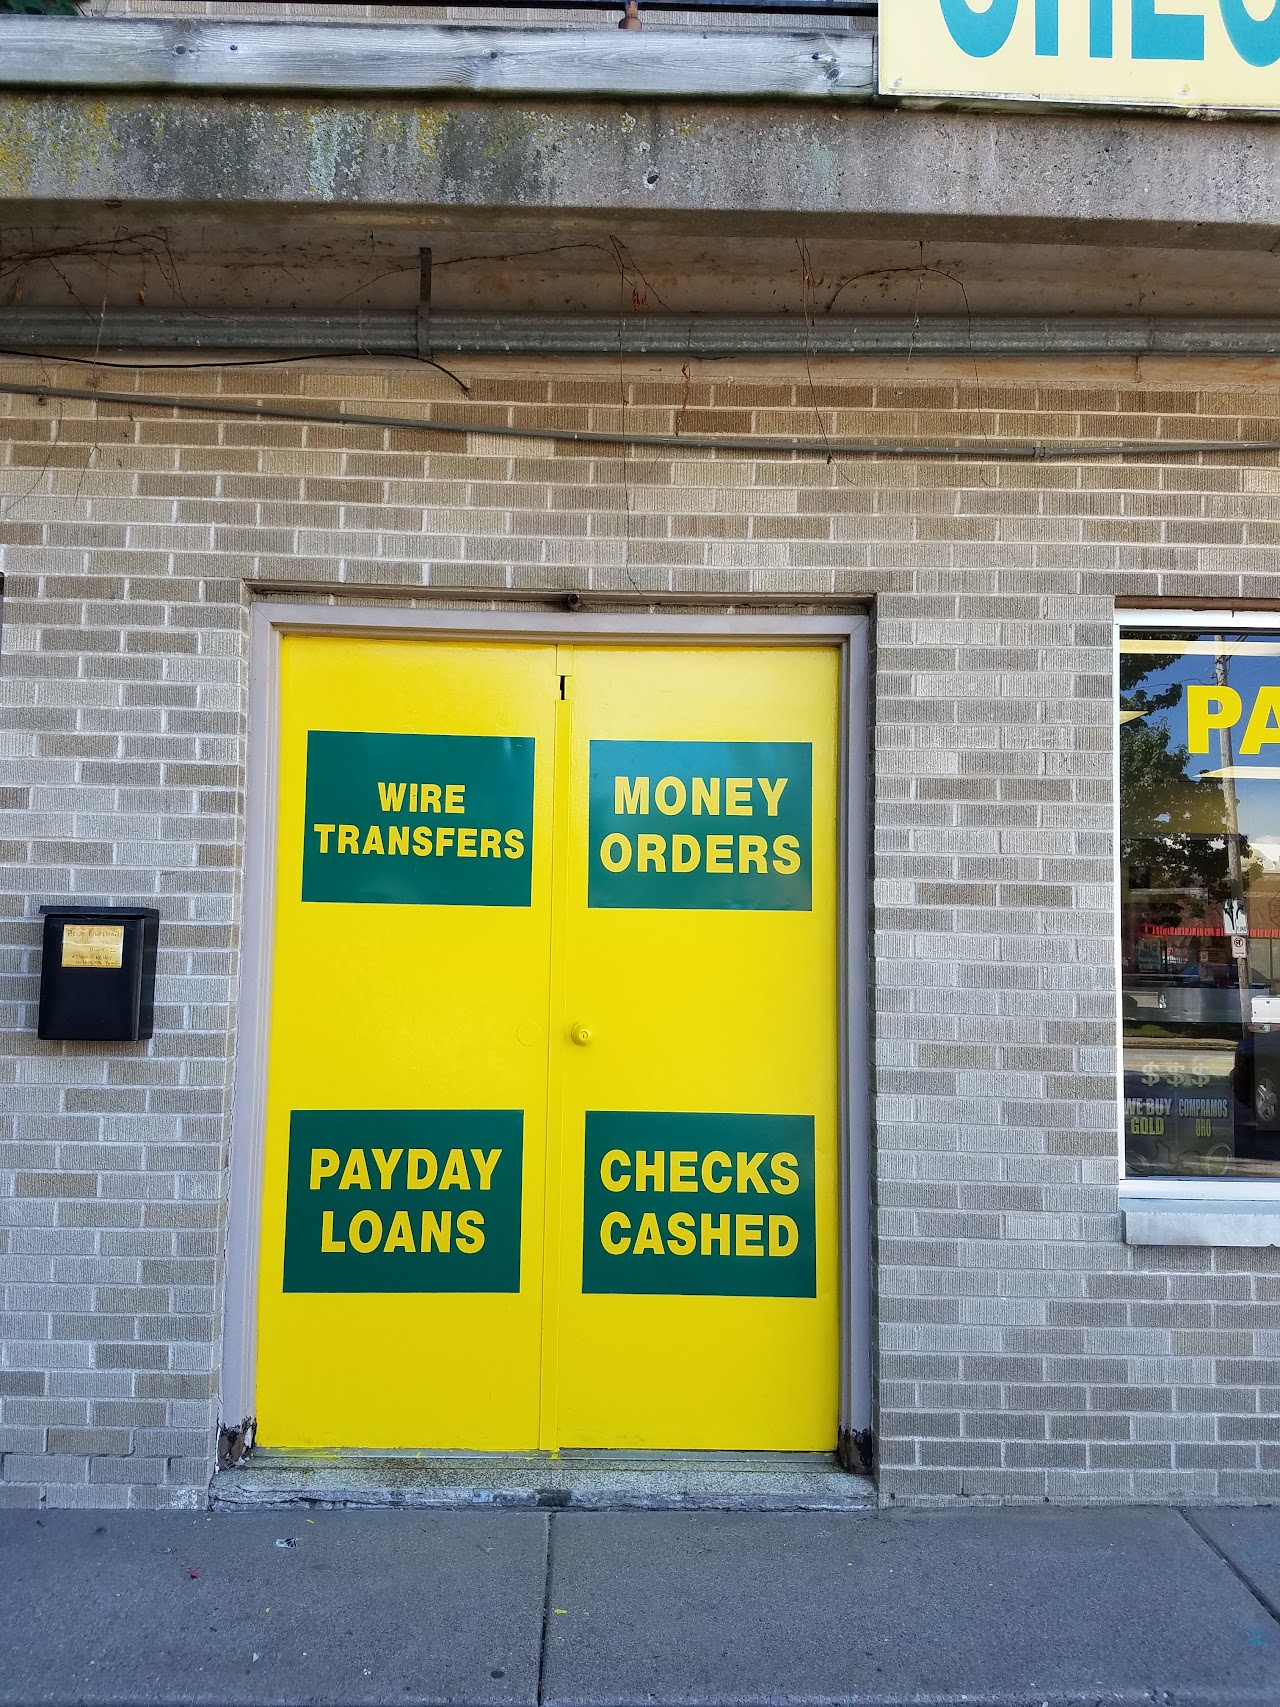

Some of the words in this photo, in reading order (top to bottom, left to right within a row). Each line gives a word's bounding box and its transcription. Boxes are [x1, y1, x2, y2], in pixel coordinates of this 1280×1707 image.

[377, 782, 465, 813] WIRE
[614, 775, 787, 816] MONEY
[313, 823, 524, 858] TRANSFERS
[599, 832, 800, 874] ORDERS
[1130, 1116, 1165, 1135] GOLD
[1146, 1098, 1172, 1116] BUY
[1179, 1098, 1228, 1118] COMPRAMOS
[1195, 1118, 1212, 1137] ORO
[309, 1148, 501, 1190] PAYDAY
[600, 1149, 799, 1194] CHECKS
[321, 1209, 484, 1253] LOANS
[600, 1211, 798, 1256] CASHED
